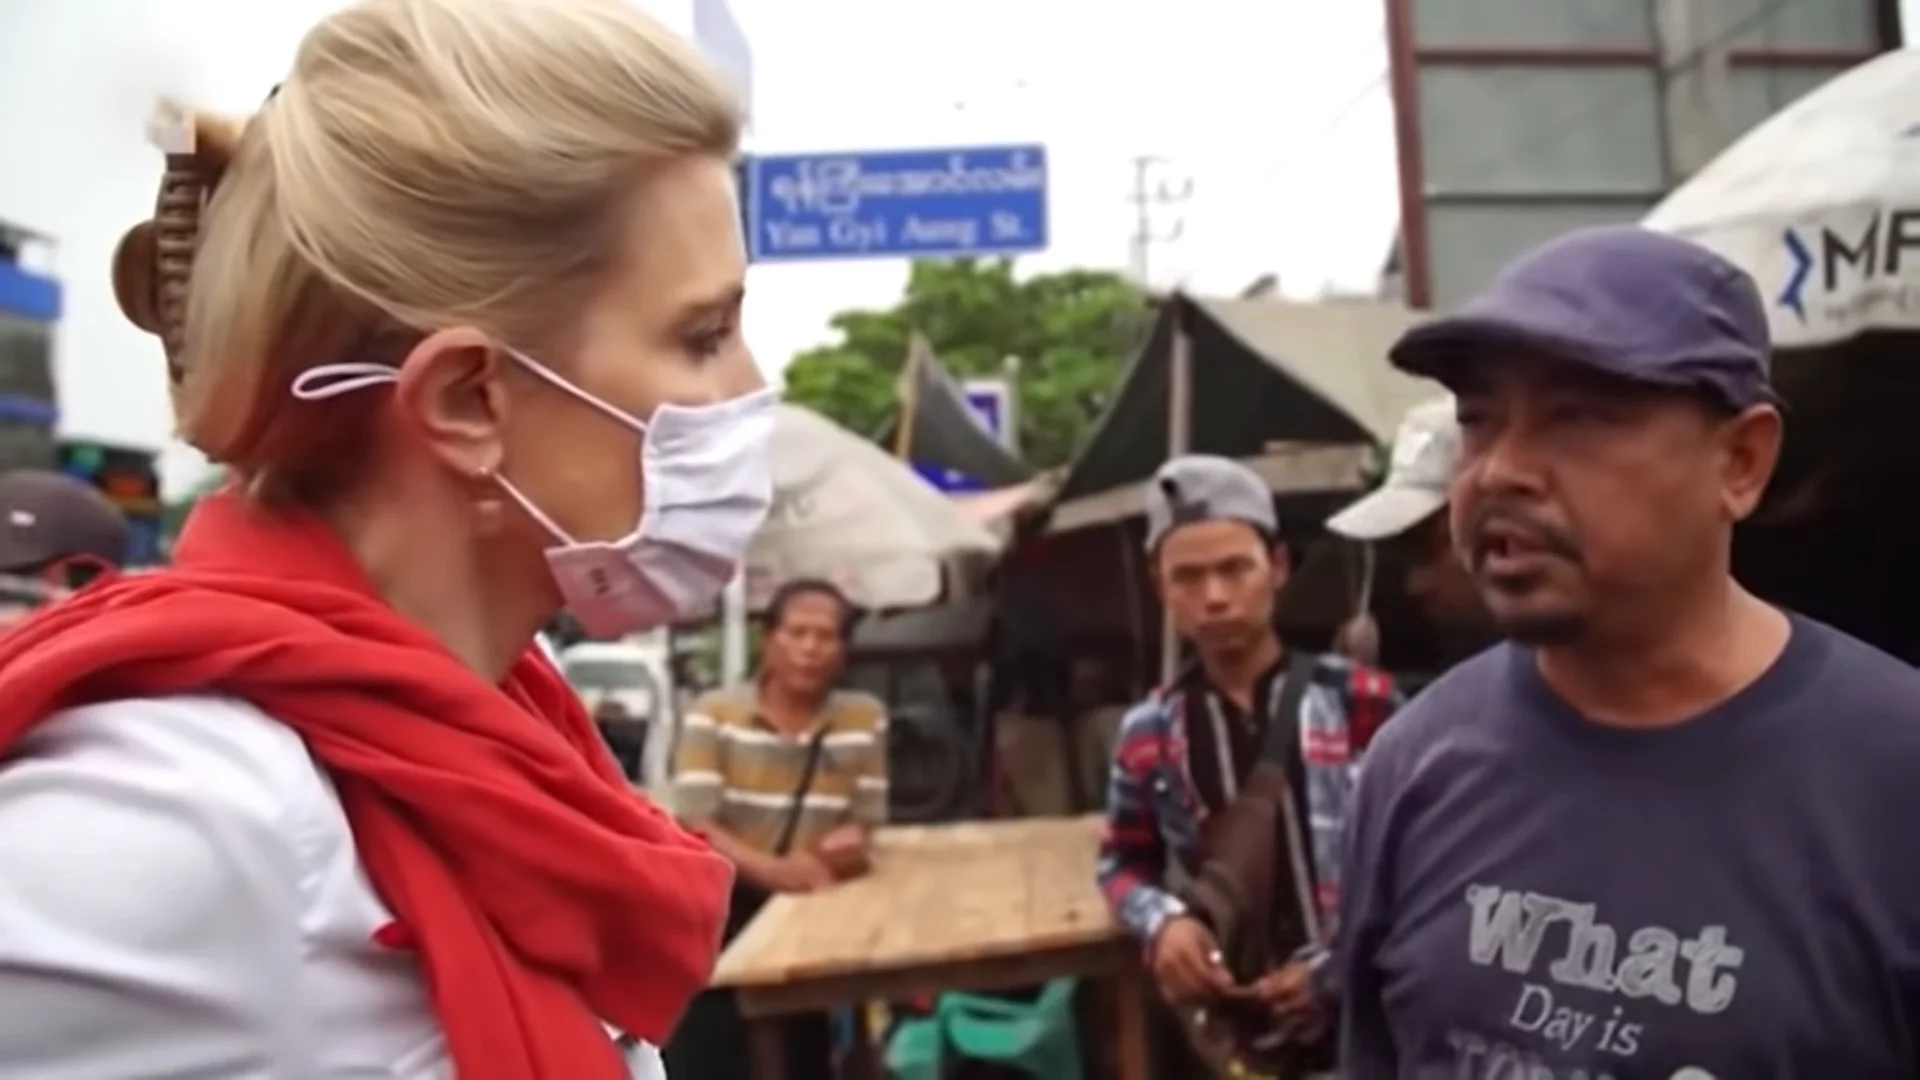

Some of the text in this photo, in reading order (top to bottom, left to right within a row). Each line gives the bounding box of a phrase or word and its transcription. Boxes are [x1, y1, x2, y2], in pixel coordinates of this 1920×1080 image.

[829, 215, 888, 253] Gyi
[1465, 883, 1743, 1014] What
[1510, 983, 1595, 1050] Day
[1597, 1005, 1643, 1056] is
